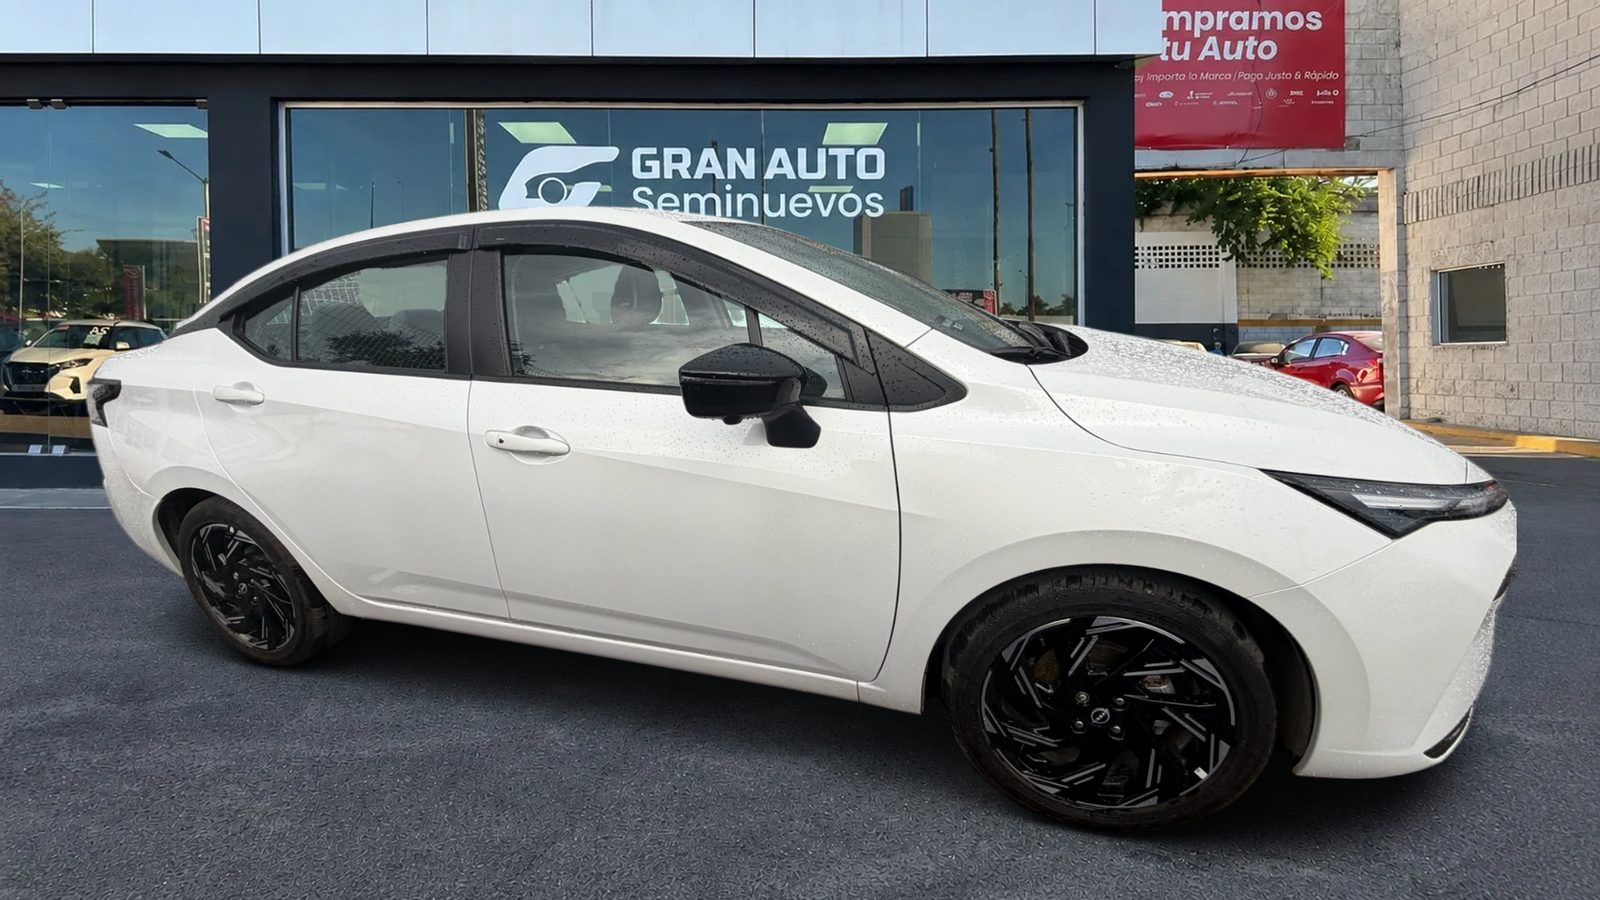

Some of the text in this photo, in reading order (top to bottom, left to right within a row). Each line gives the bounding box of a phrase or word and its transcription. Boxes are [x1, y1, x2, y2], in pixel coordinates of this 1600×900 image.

[1160, 36, 1277, 61] tu Auto
[1146, 72, 1186, 83] Importa
[1188, 71, 1198, 81] la
[1199, 71, 1232, 81] Marca
[1265, 71, 1292, 80] Justo
[1294, 71, 1301, 80] &
[631, 147, 885, 180] GRAN AUTO
[632, 184, 885, 218] Seminuevos
